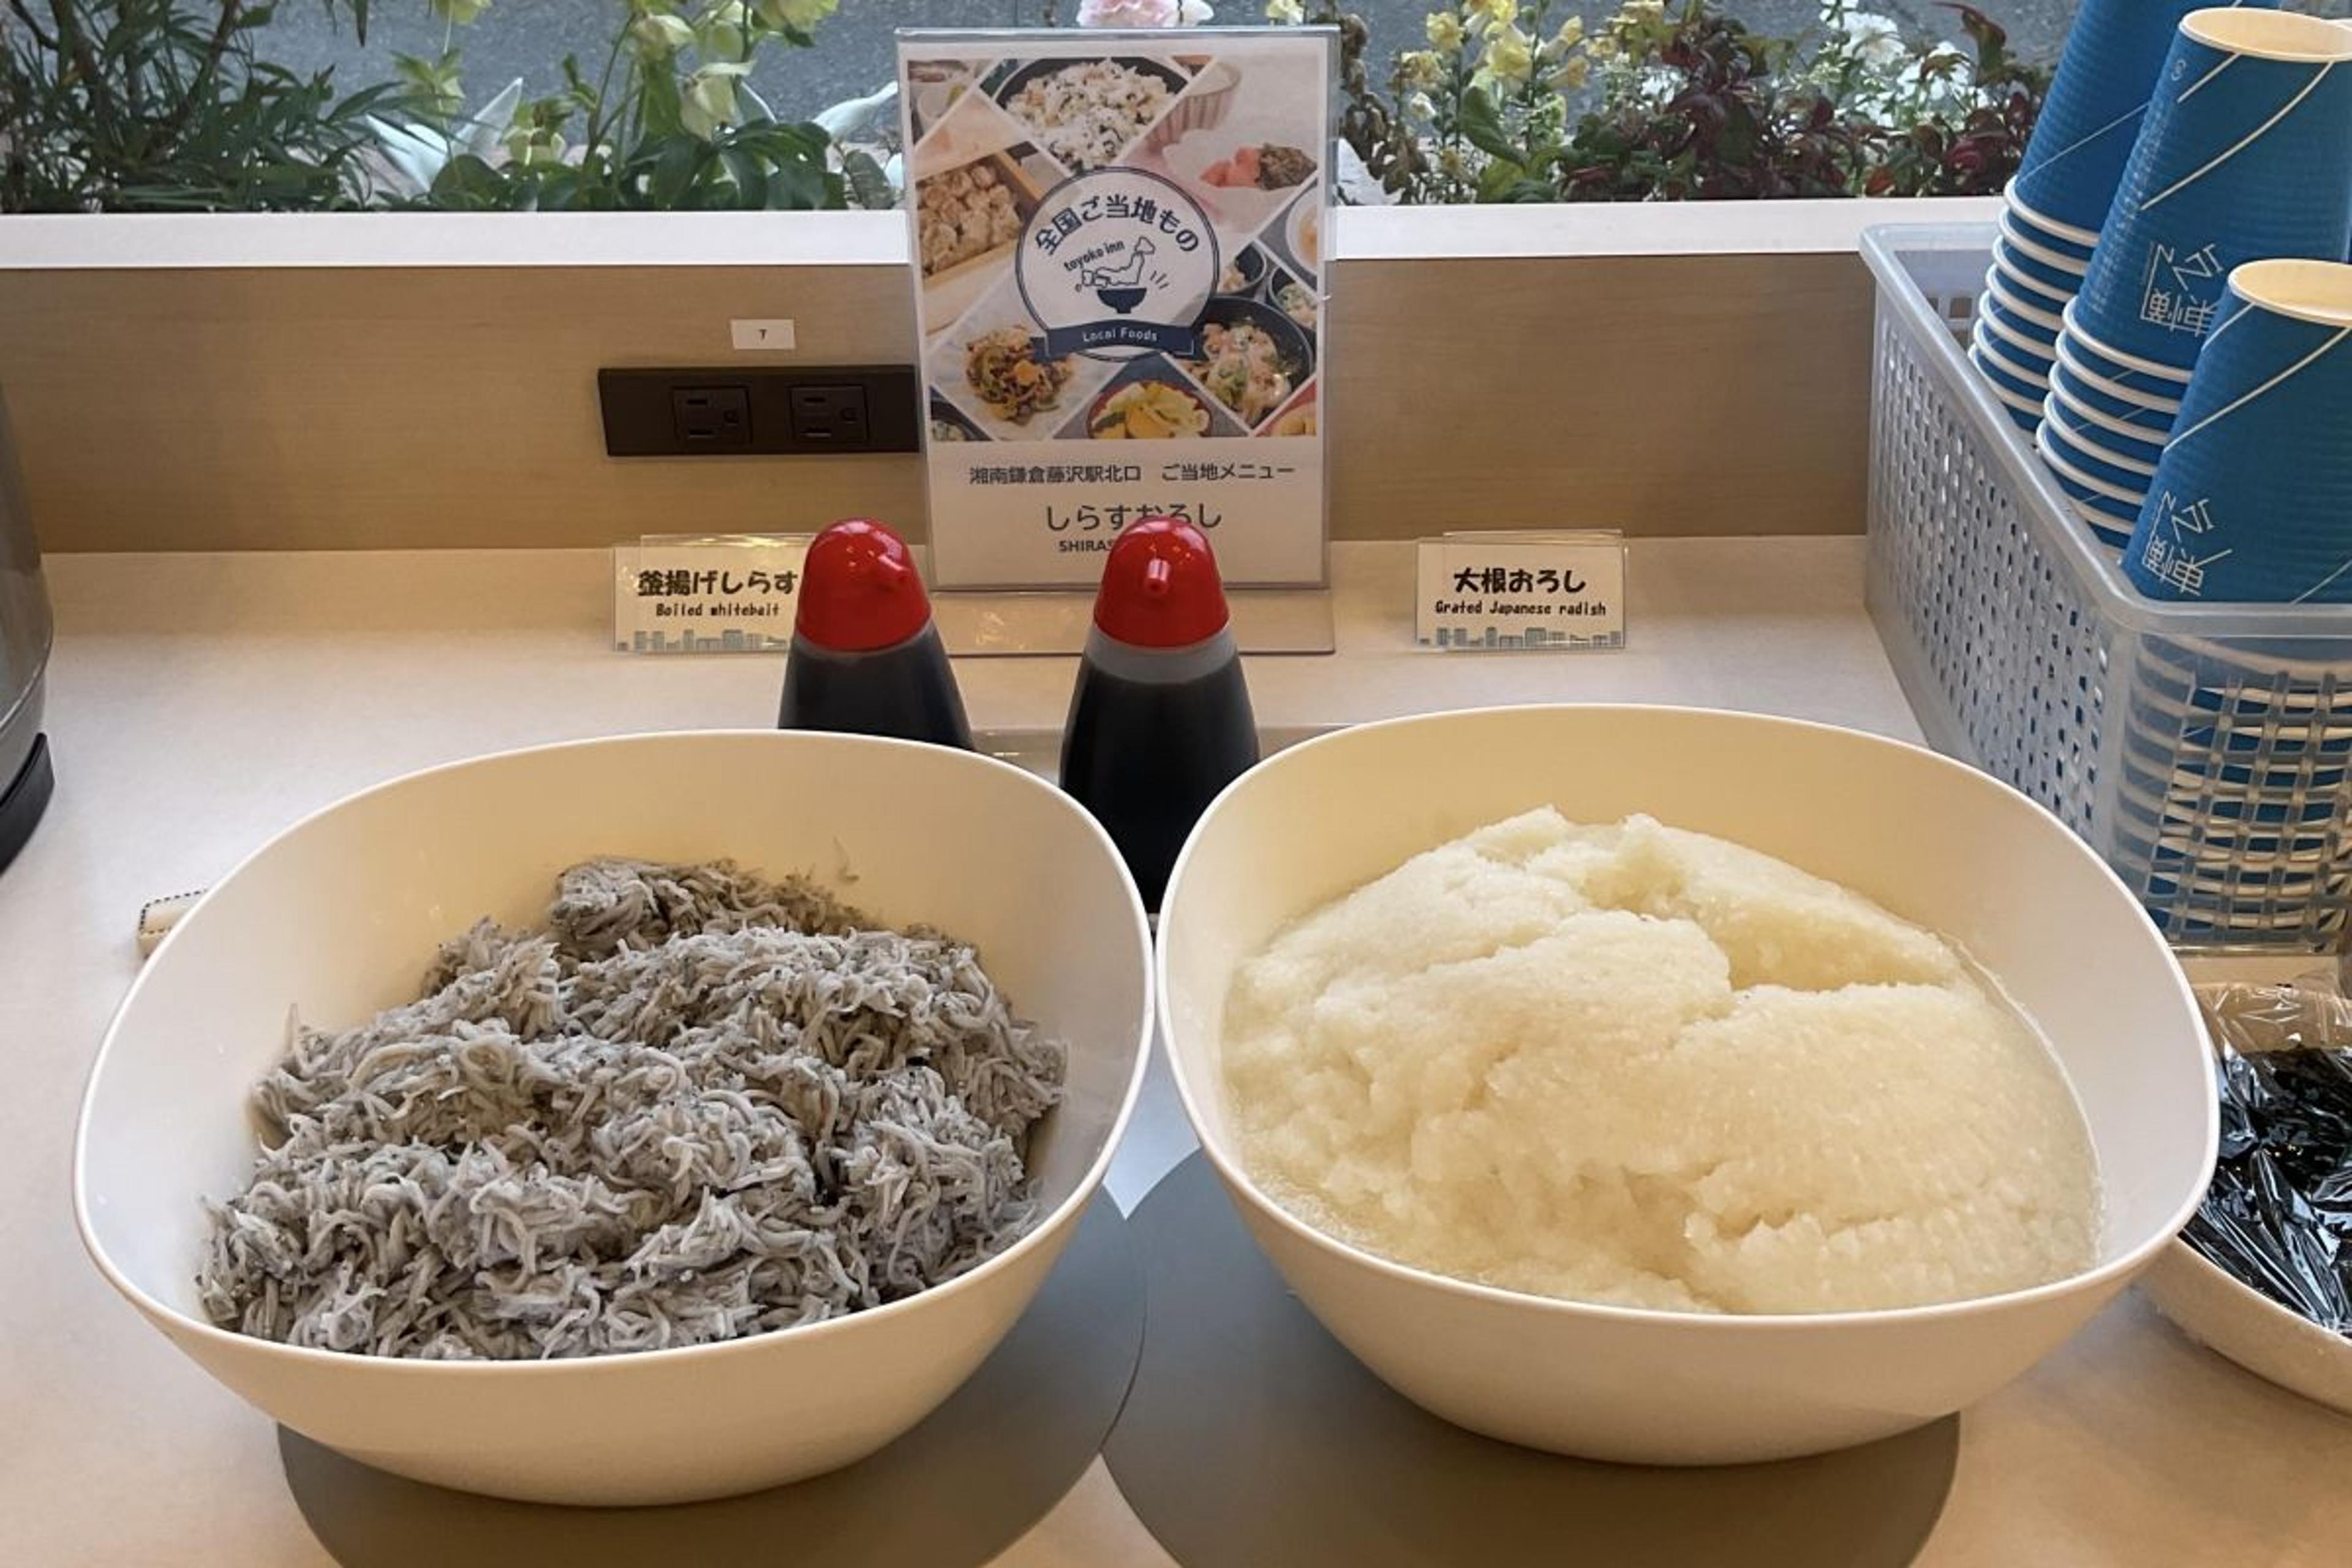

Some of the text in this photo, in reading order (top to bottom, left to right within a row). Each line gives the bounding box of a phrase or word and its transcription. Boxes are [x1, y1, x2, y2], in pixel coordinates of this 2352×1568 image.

[1035, 194, 1199, 255] 全国ご当地もの
[1064, 239, 1125, 272] toyoko inn
[1082, 326, 1157, 342] Local Foods
[970, 463, 1295, 484] 湘南鎌倉藤沢駅北口 ご当地メニュー
[638, 570, 798, 596] 釜揚げしらす
[1454, 567, 1586, 594] 大根おろし
[656, 603, 779, 617] Boiled whitebait
[1435, 600, 1607, 616] Grated Japanese radish
